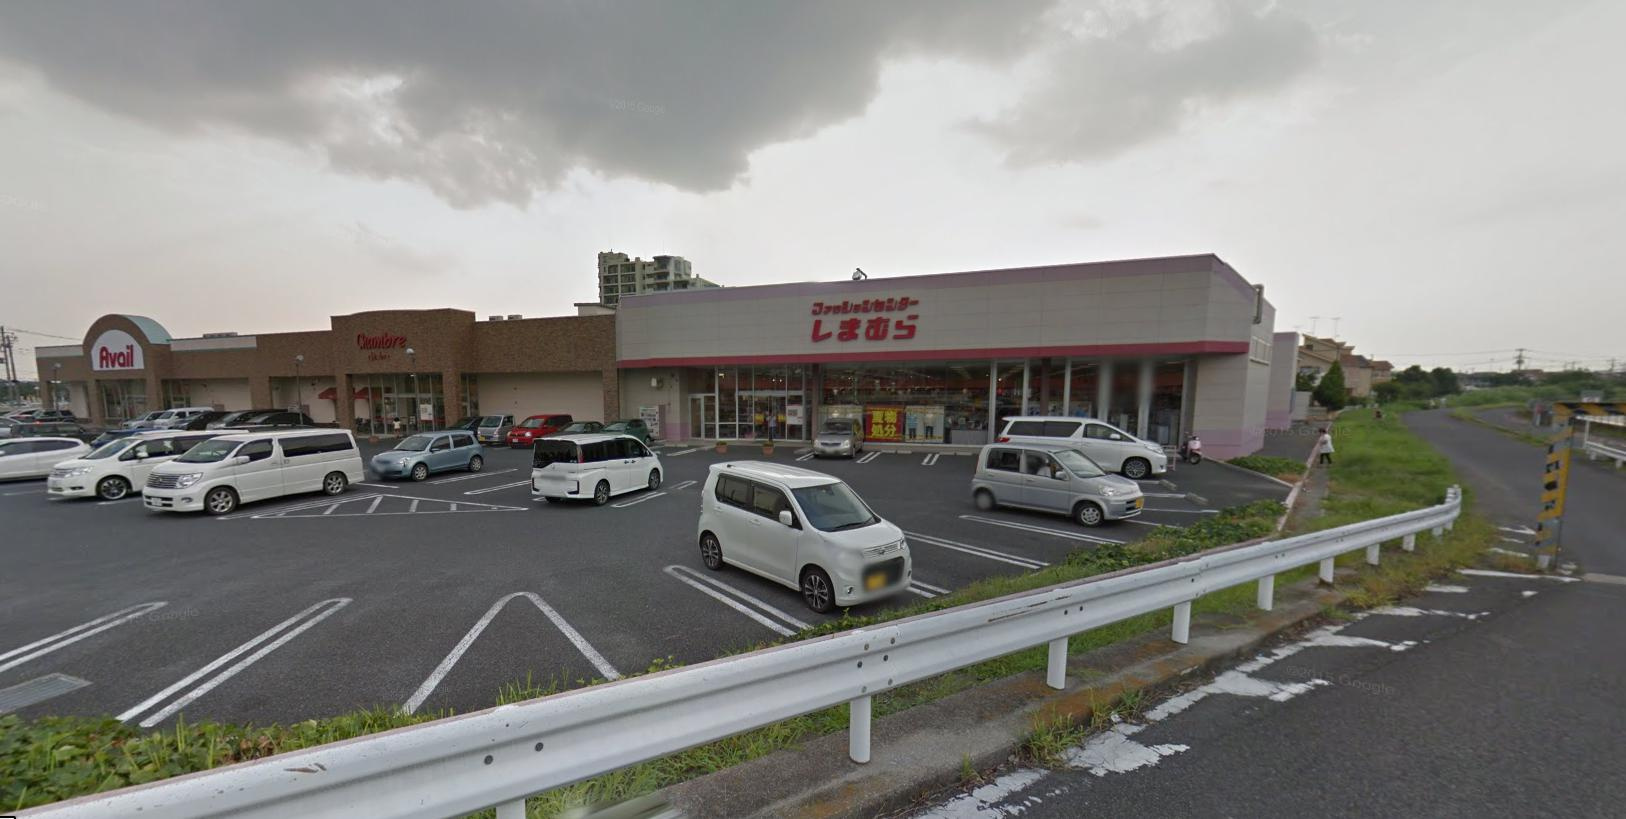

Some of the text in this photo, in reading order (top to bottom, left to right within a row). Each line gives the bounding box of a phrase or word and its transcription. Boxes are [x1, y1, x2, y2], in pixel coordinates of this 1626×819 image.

[811, 296, 920, 316] ファッションセンター
[811, 314, 920, 343] しまむら
[99, 344, 134, 368] Avail
